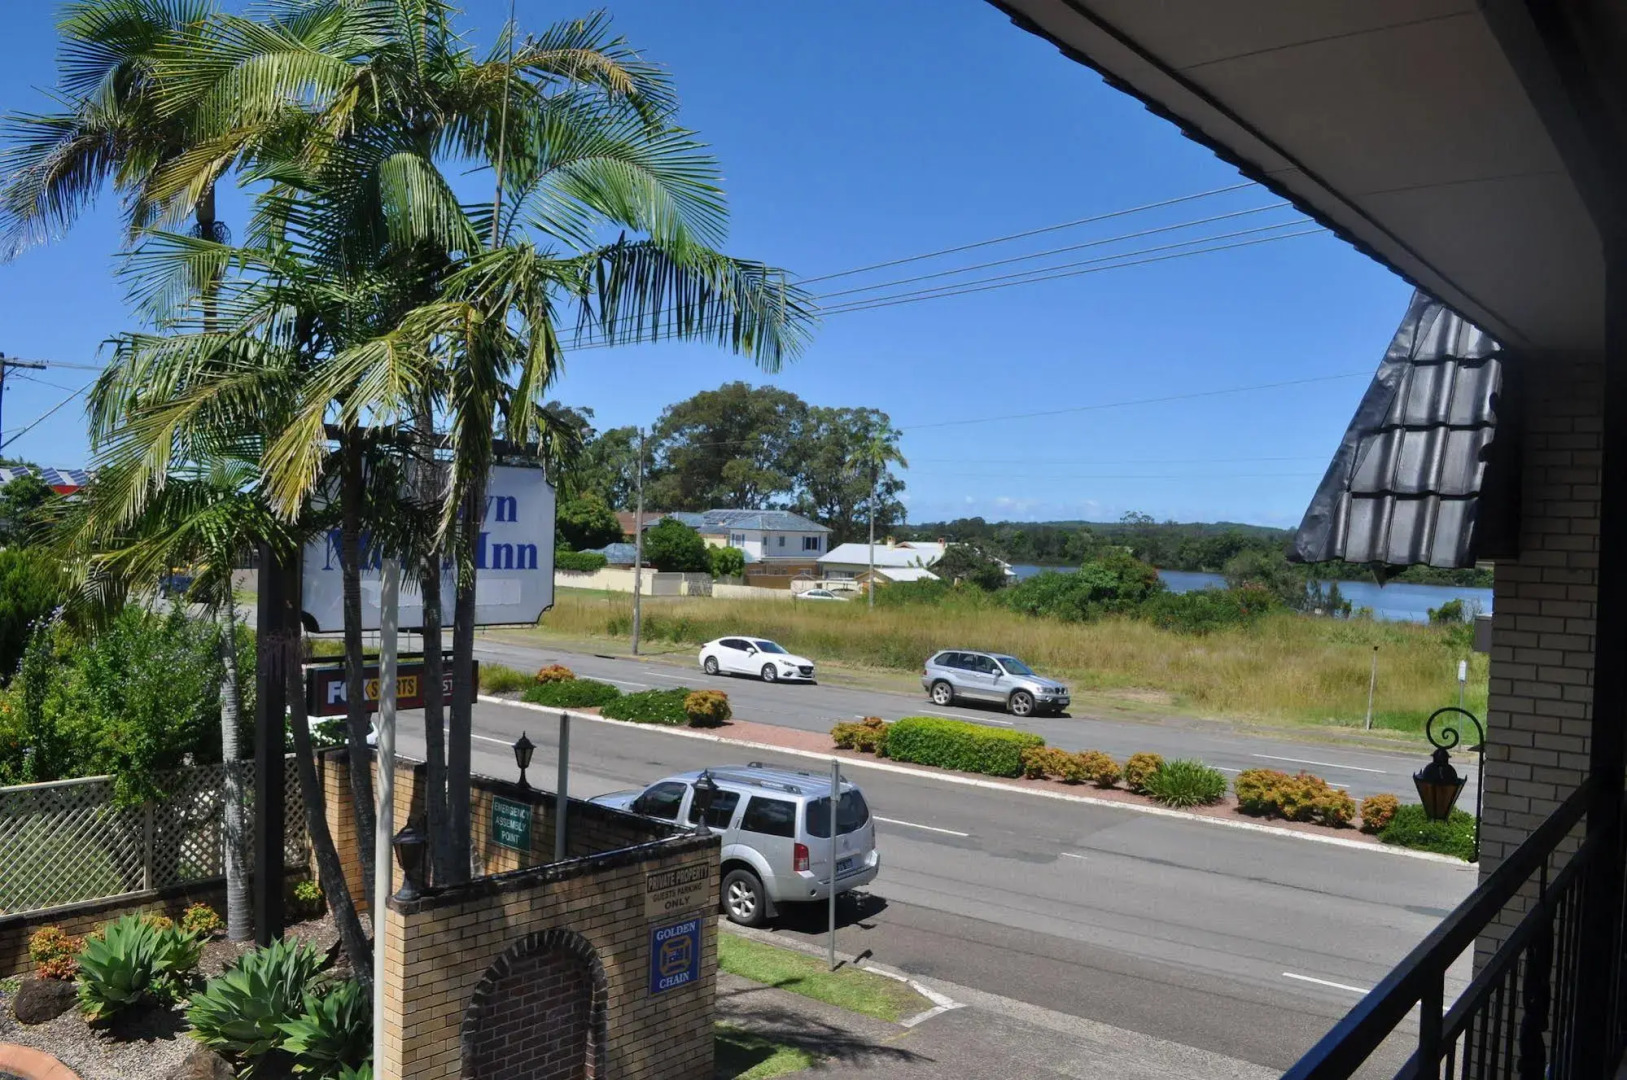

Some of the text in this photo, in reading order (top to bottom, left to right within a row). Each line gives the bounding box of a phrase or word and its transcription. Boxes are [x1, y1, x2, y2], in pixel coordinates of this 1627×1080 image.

[476, 531, 538, 570] Inn
[501, 830, 520, 844] POINT
[648, 864, 708, 891] PRIVATE PROPERTY
[664, 895, 691, 910] ONLY
[656, 921, 696, 941] GOLDEN
[659, 971, 690, 989] CHAIN
